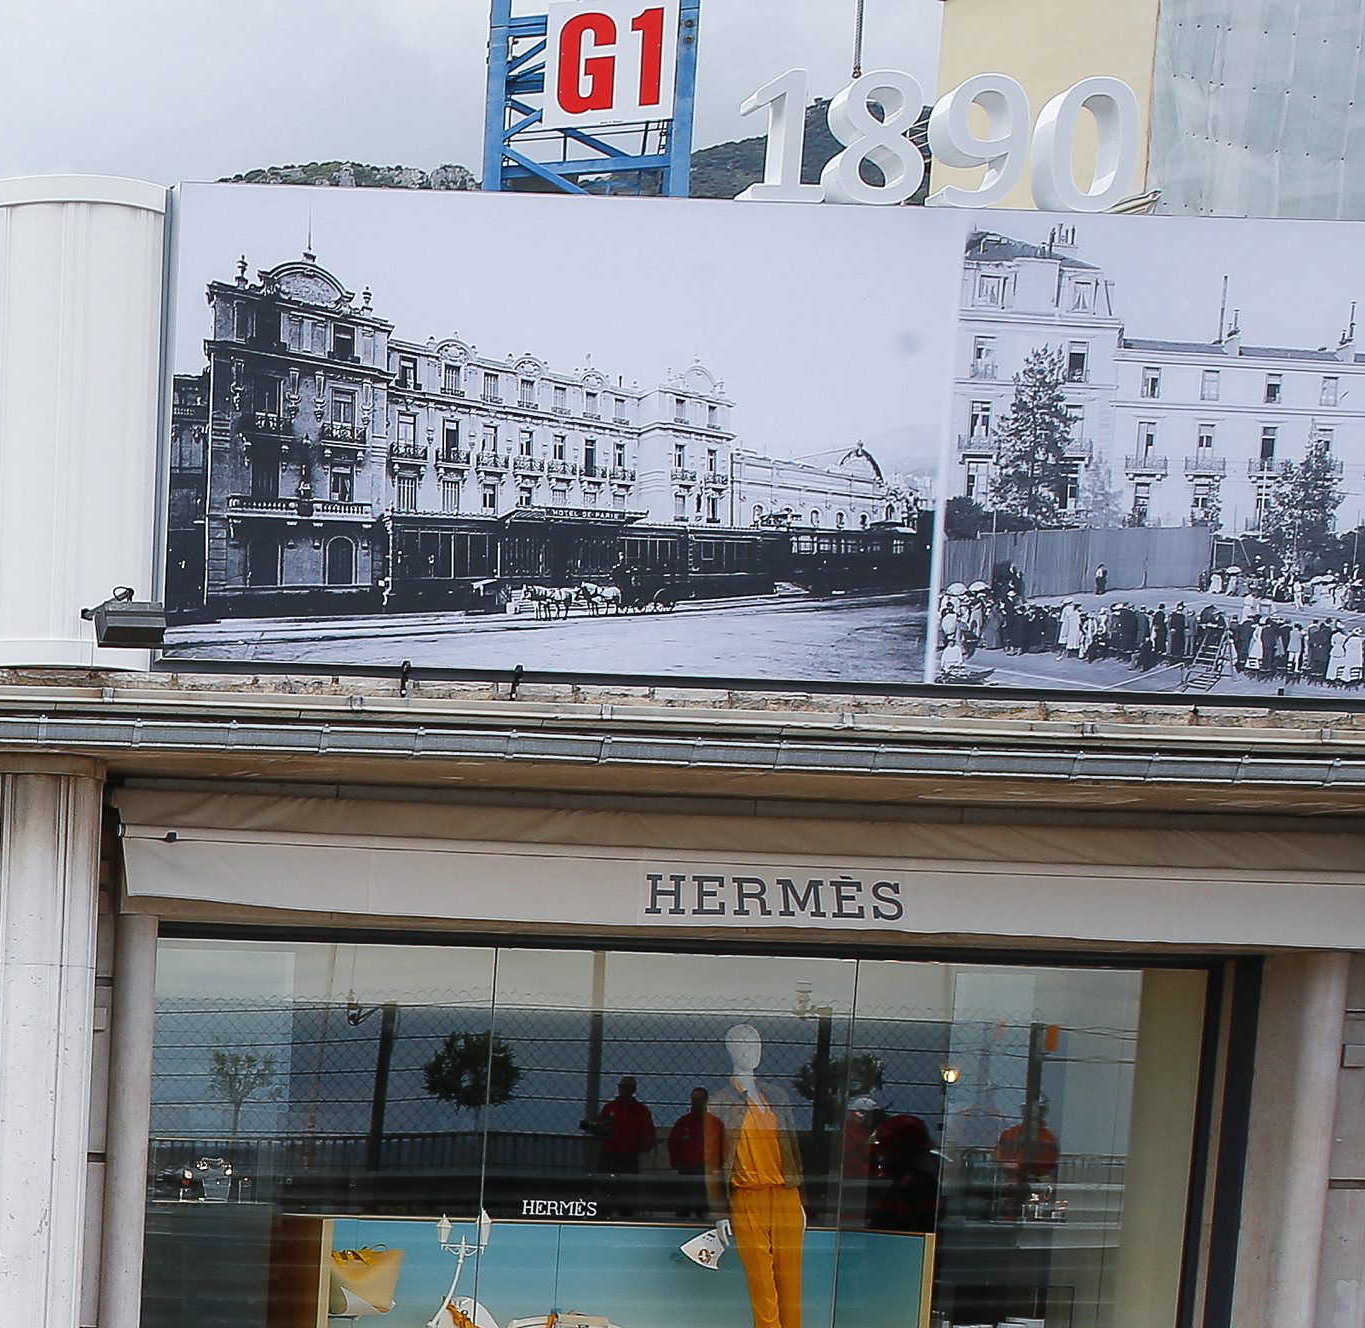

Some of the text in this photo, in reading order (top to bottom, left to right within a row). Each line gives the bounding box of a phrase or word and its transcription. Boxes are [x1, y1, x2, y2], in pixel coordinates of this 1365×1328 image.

[557, 7, 665, 115] G1
[734, 68, 1141, 212] 1890
[644, 873, 905, 922] HERMÈS
[522, 1198, 597, 1217] HERMÈS
